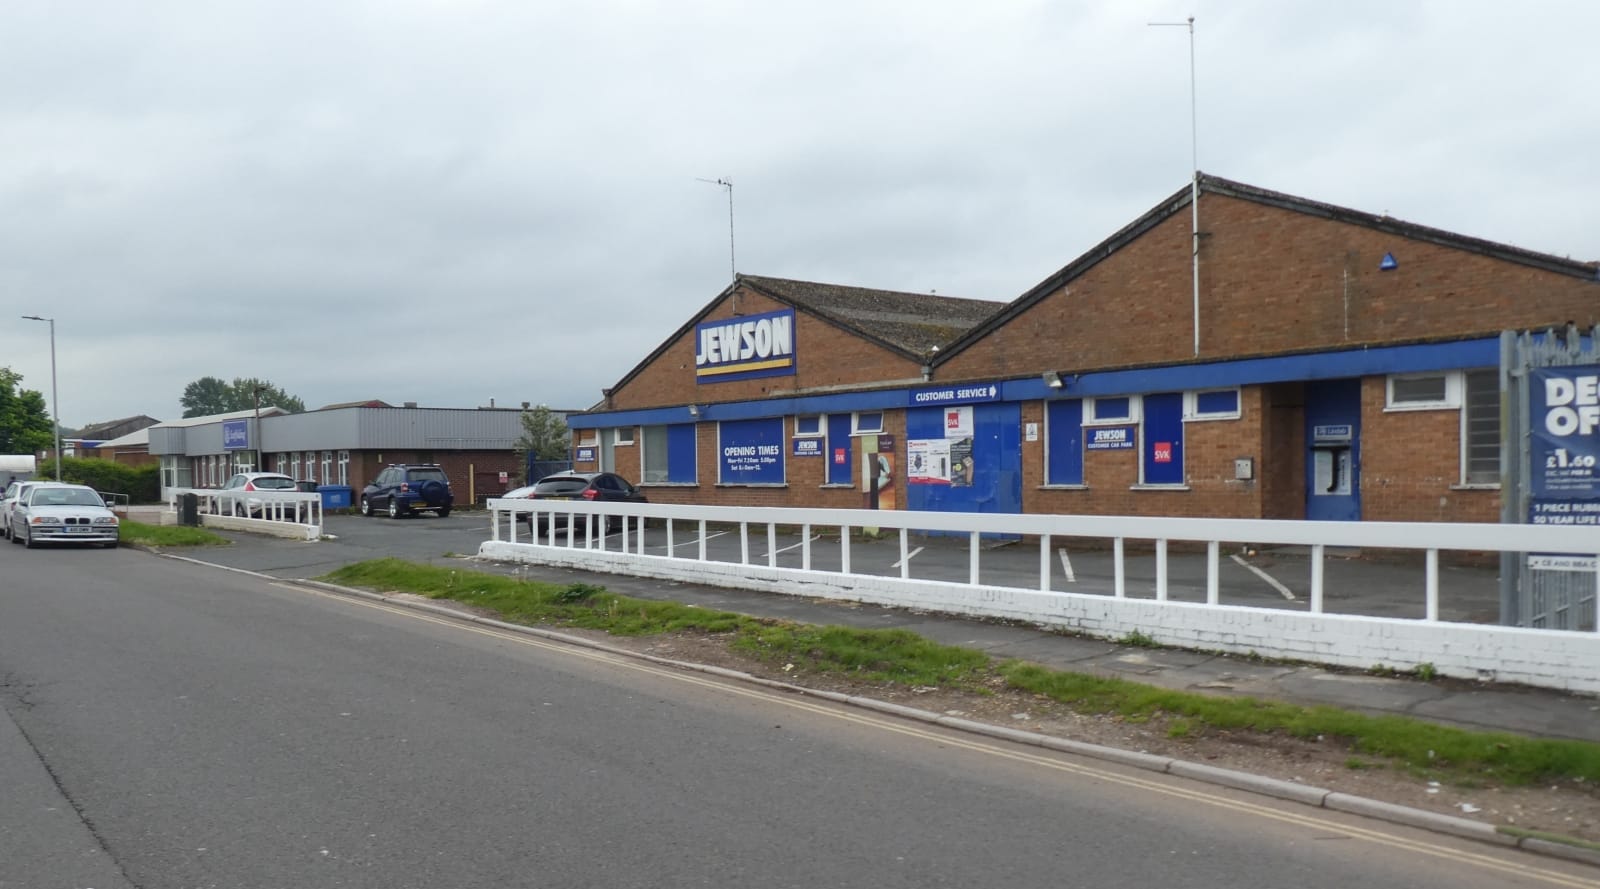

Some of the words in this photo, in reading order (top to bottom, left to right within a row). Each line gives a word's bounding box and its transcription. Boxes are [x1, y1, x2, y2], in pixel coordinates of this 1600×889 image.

[696, 315, 792, 365] JEWSON
[915, 391, 954, 402] CUSTOMER
[957, 388, 987, 399] SERVICE
[1546, 376, 1600, 406] DE
[1094, 429, 1126, 440] JEWSON
[724, 446, 756, 457] OPENING
[758, 445, 779, 456] TIMES
[1154, 450, 1170, 460] SVK
[1545, 448, 1595, 468] £1.60
[1542, 503, 1571, 513] PIECE
[1548, 515, 1574, 525] YEAR
[1576, 515, 1596, 525] LIFE
